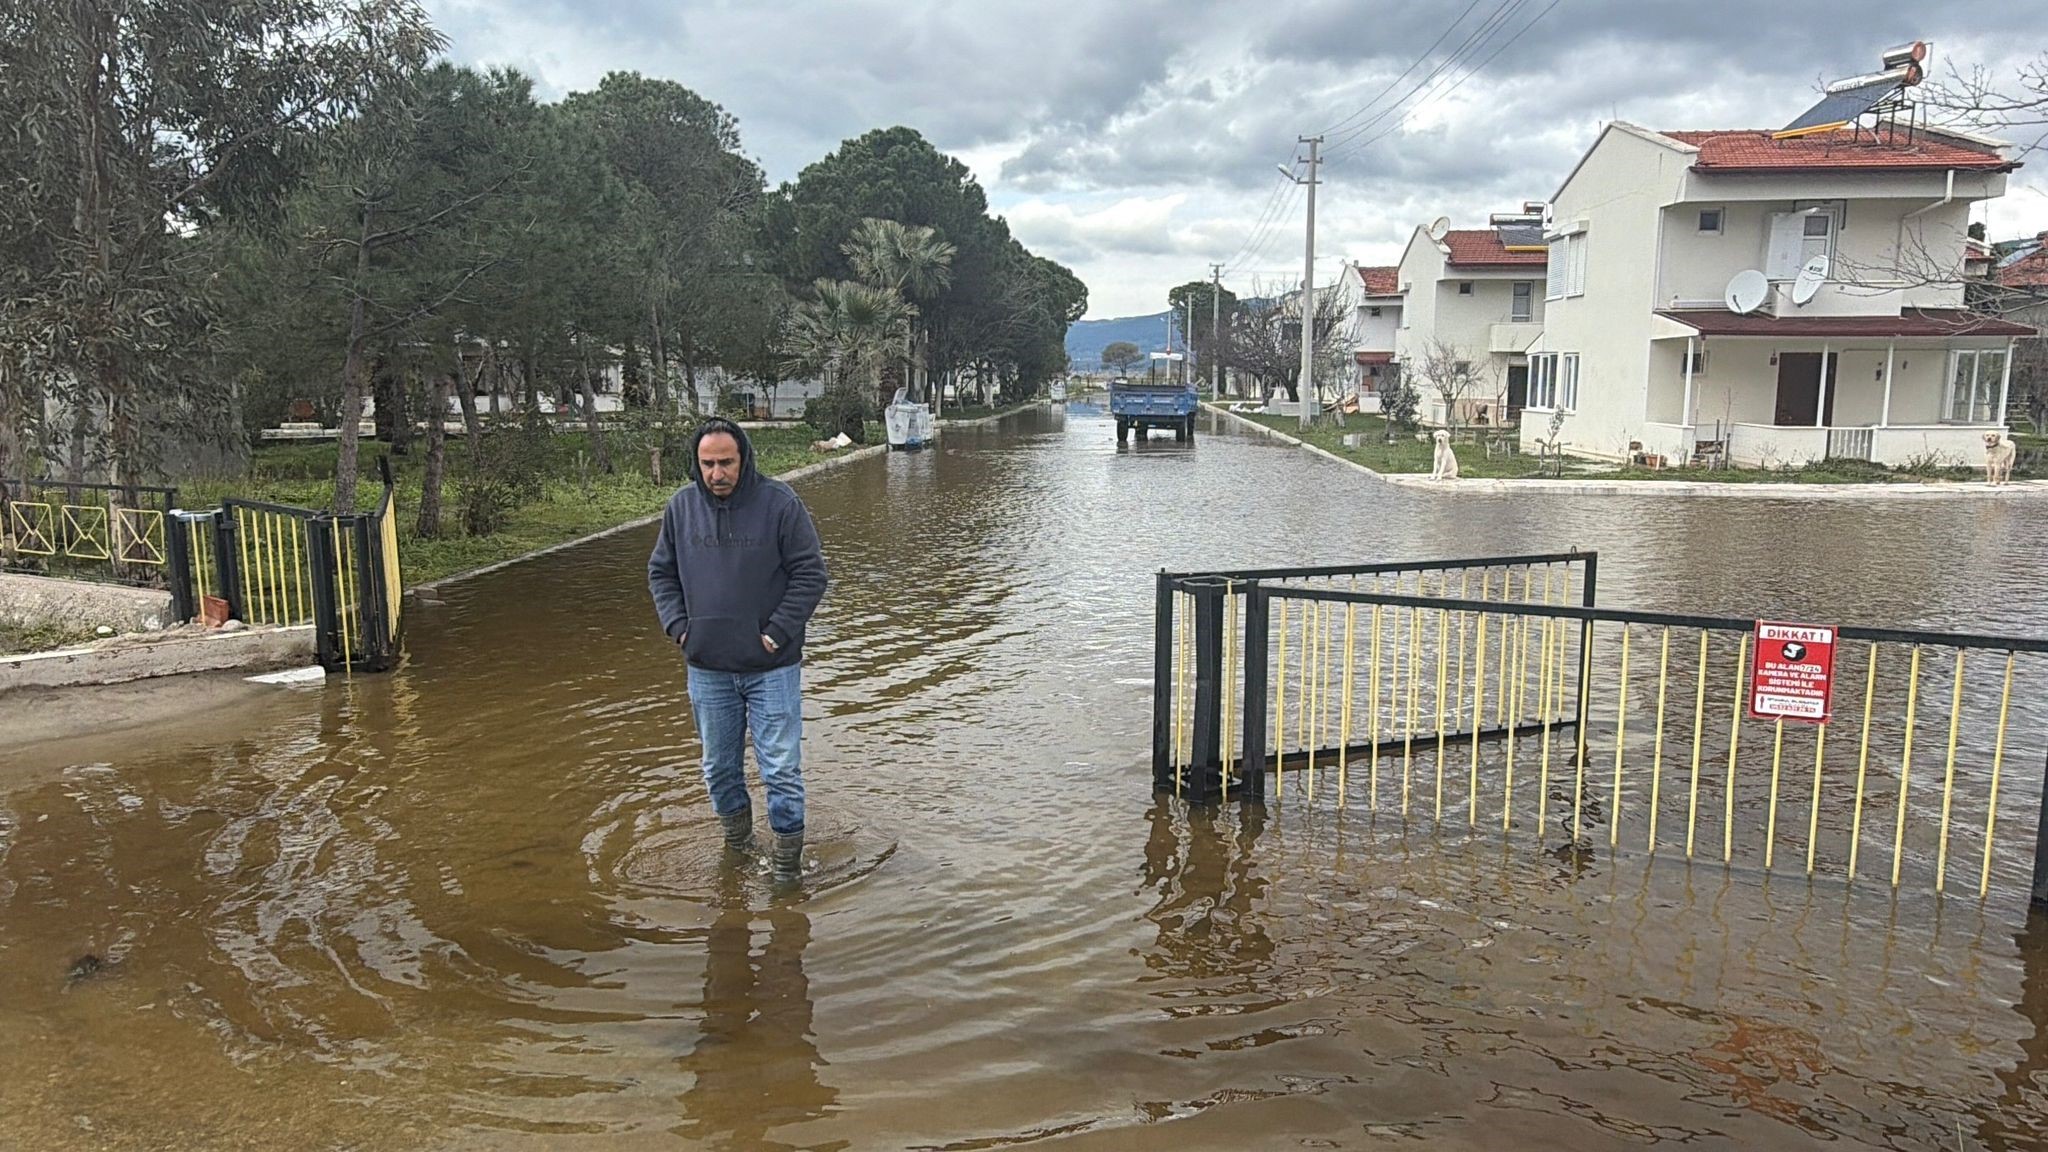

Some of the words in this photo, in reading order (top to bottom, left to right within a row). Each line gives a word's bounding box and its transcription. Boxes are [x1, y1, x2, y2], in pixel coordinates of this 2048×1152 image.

[1767, 629, 1816, 641] DİKKAT
[1777, 663, 1800, 671] ALAN
[1801, 664, 1820, 672] 7/24
[1757, 669, 1788, 678] KAMERA
[1789, 671, 1799, 679] VE
[1800, 672, 1826, 681] ALARM
